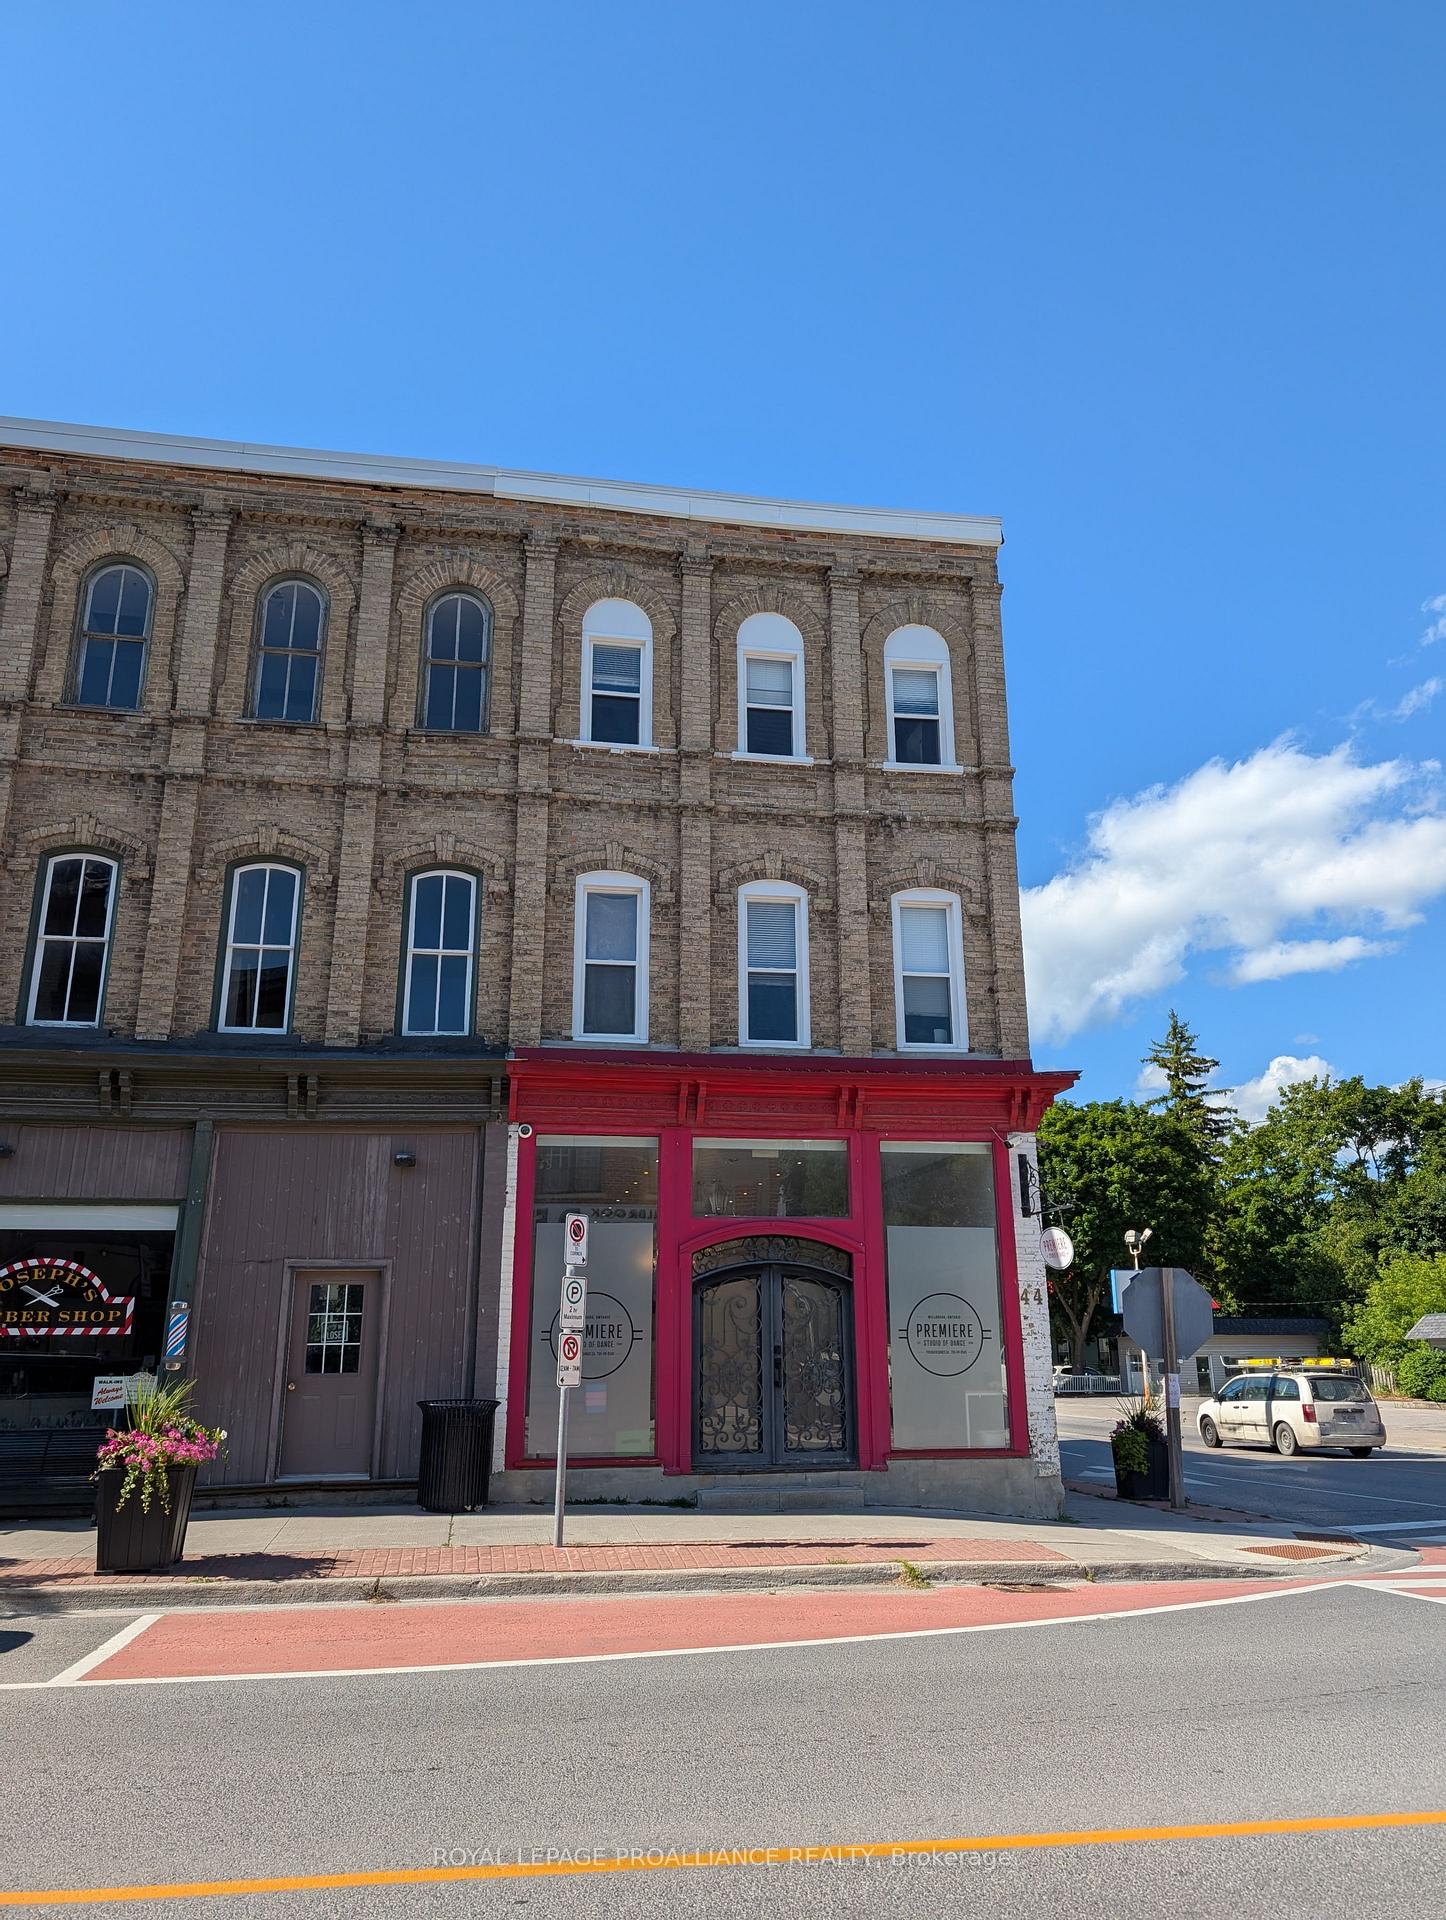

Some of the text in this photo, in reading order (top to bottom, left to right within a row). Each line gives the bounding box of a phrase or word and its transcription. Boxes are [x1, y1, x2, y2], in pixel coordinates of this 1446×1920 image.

[0, 1268, 98, 1302] OSEPH'S
[571, 1286, 579, 1299] P
[1021, 1288, 1043, 1305] 44
[0, 1310, 121, 1323] BER SHOP
[325, 1330, 344, 1340] LOSE
[585, 1323, 623, 1339] MIERE
[916, 1323, 974, 1338] PREMIERE
[597, 1340, 614, 1348] DANCE
[923, 1339, 941, 1347] STUDIO
[942, 1339, 949, 1347] OF
[950, 1339, 966, 1347] DANCE
[97, 1386, 123, 1396] Always
[94, 1393, 124, 1405] Welcome
